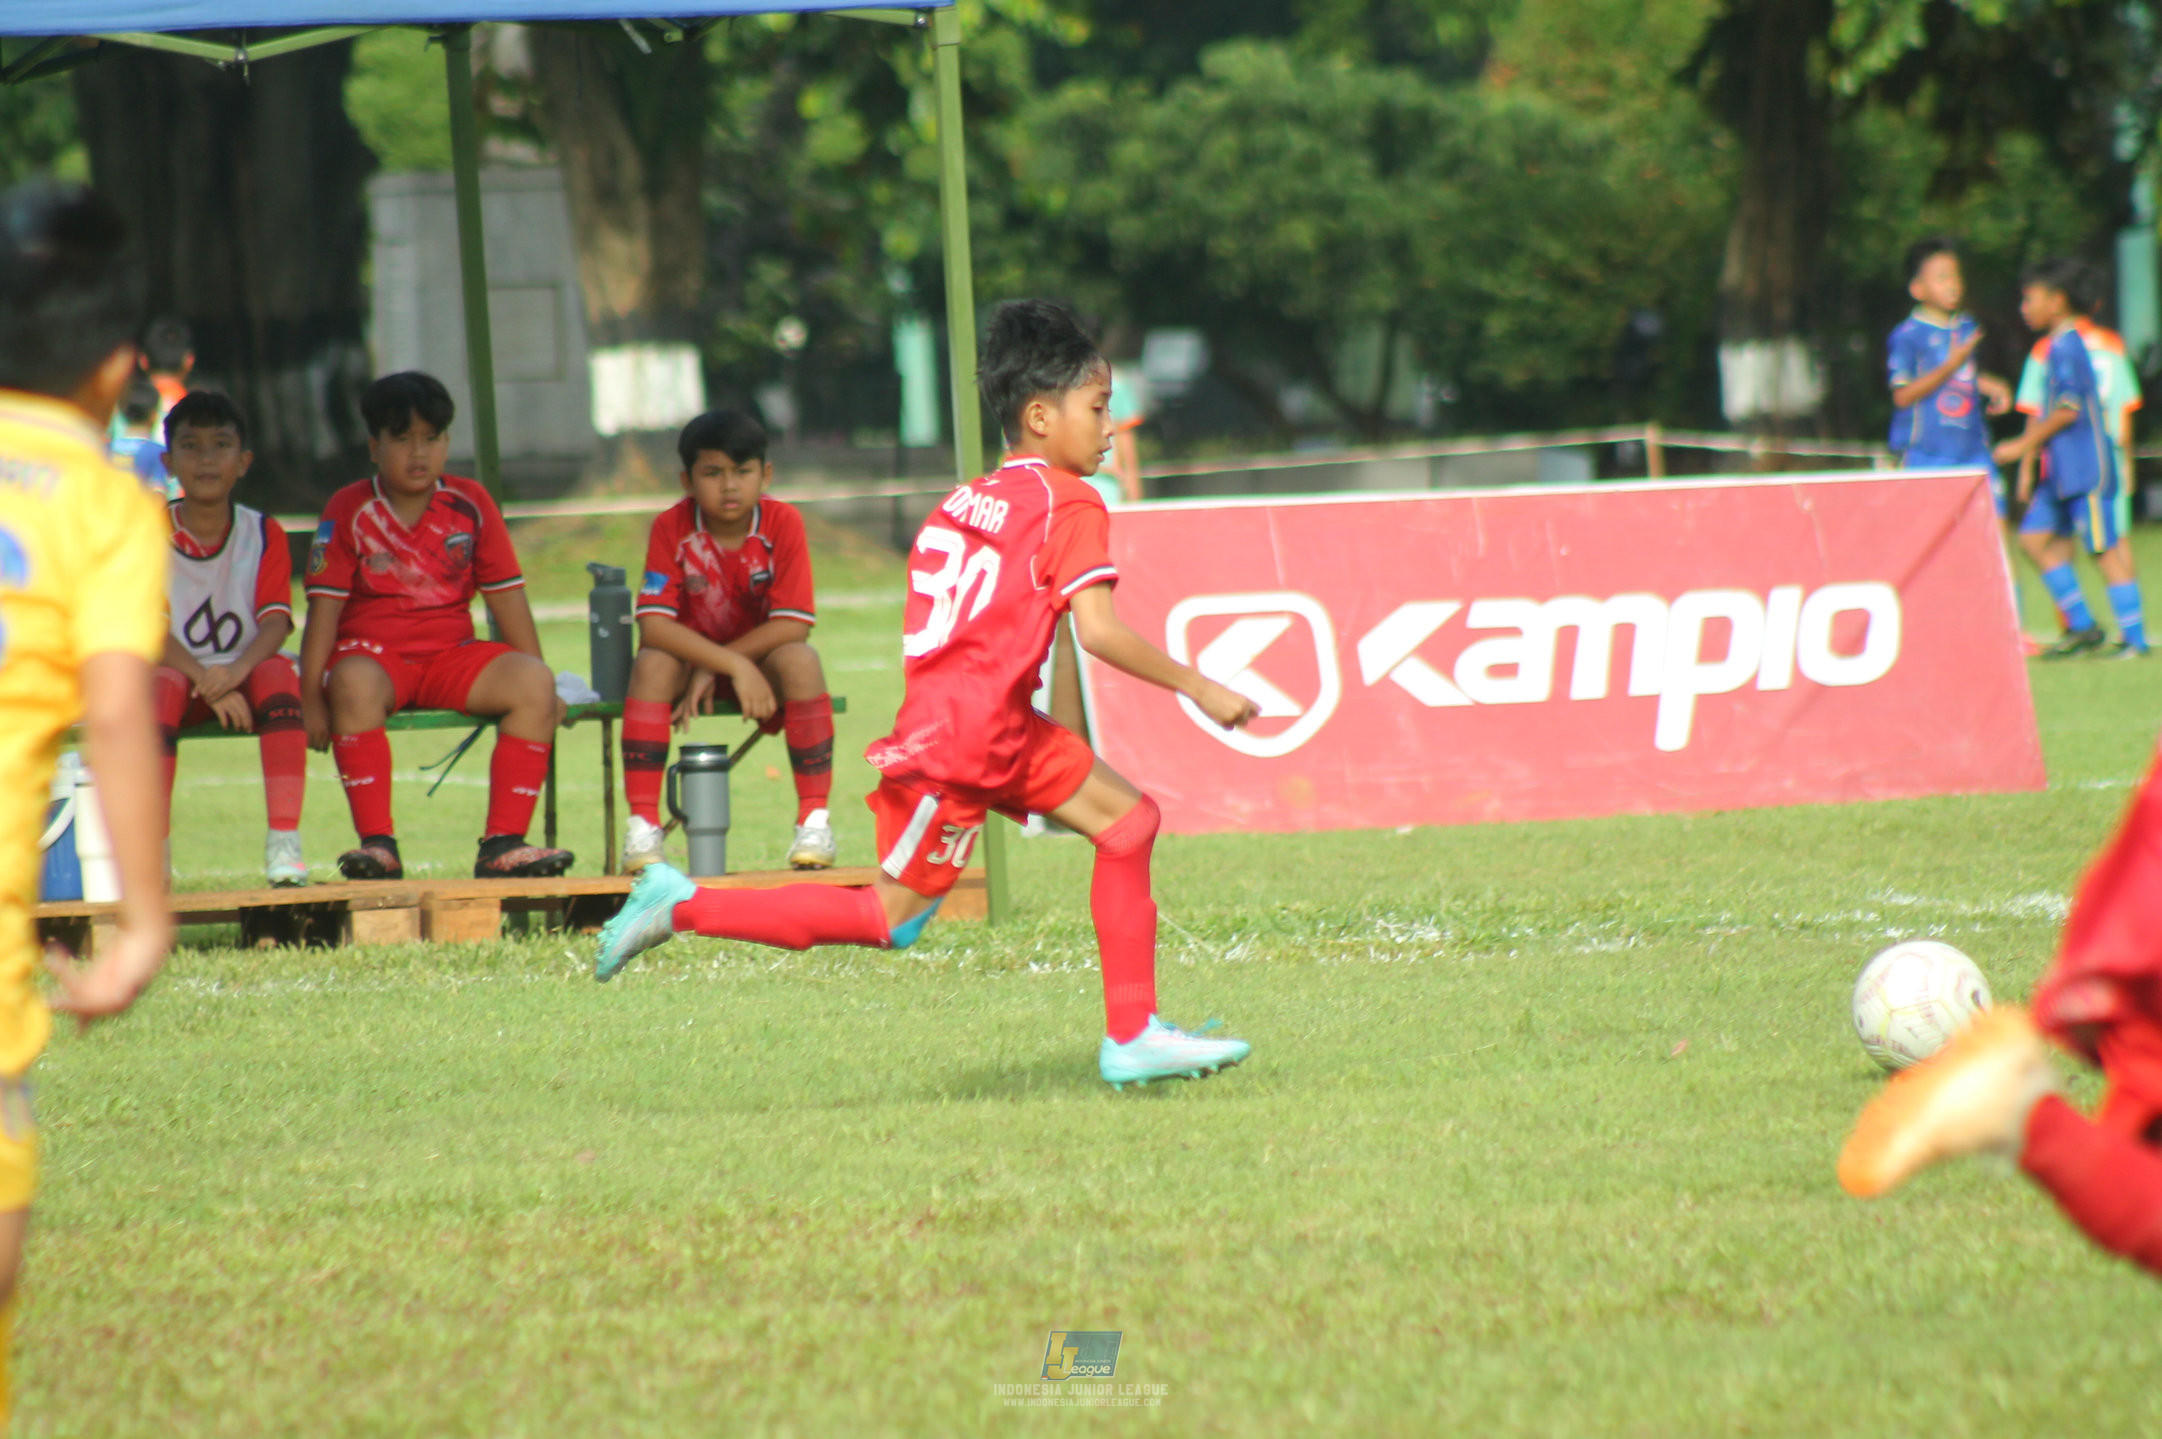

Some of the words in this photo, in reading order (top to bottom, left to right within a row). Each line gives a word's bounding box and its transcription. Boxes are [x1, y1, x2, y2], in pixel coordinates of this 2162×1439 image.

[942, 485, 1009, 534] OMAR
[903, 525, 1001, 657] 30
[1356, 581, 1902, 752] Kampio
[926, 824, 985, 868] 30
